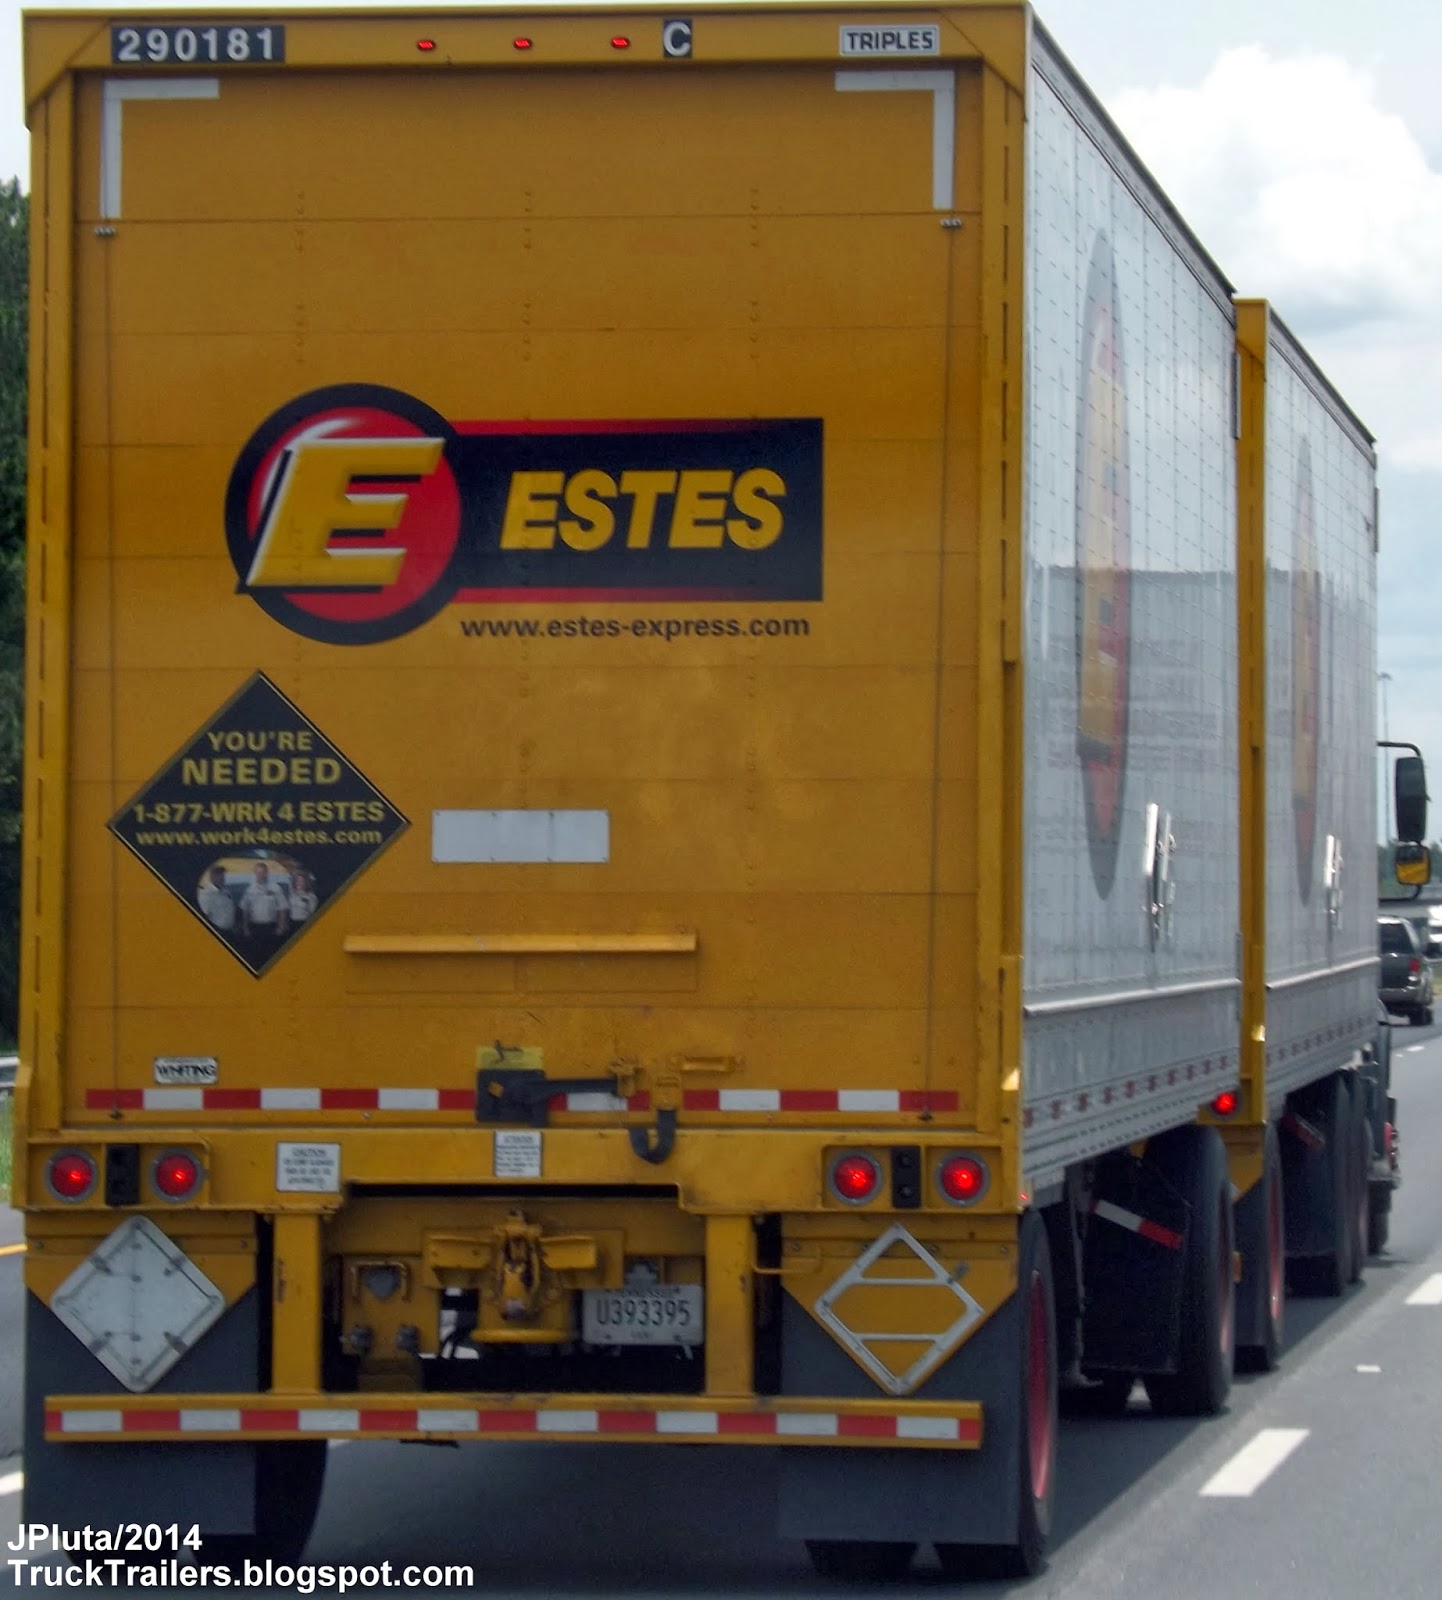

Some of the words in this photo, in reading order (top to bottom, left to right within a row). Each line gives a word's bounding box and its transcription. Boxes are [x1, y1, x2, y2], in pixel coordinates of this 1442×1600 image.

[118, 28, 273, 62] 290181
[663, 21, 691, 57] C
[847, 31, 933, 50] TRIPLES
[500, 469, 787, 552] ESTES
[461, 616, 811, 642] www.estes-express.com
[207, 731, 313, 752] YOU'RE
[181, 758, 341, 786] NEEDED
[134, 802, 272, 824] 1-877-WRK
[278, 803, 295, 823] 4
[300, 801, 385, 823] ESTES
[136, 827, 382, 846] www.work4estes.com
[597, 1300, 691, 1326] U393395
